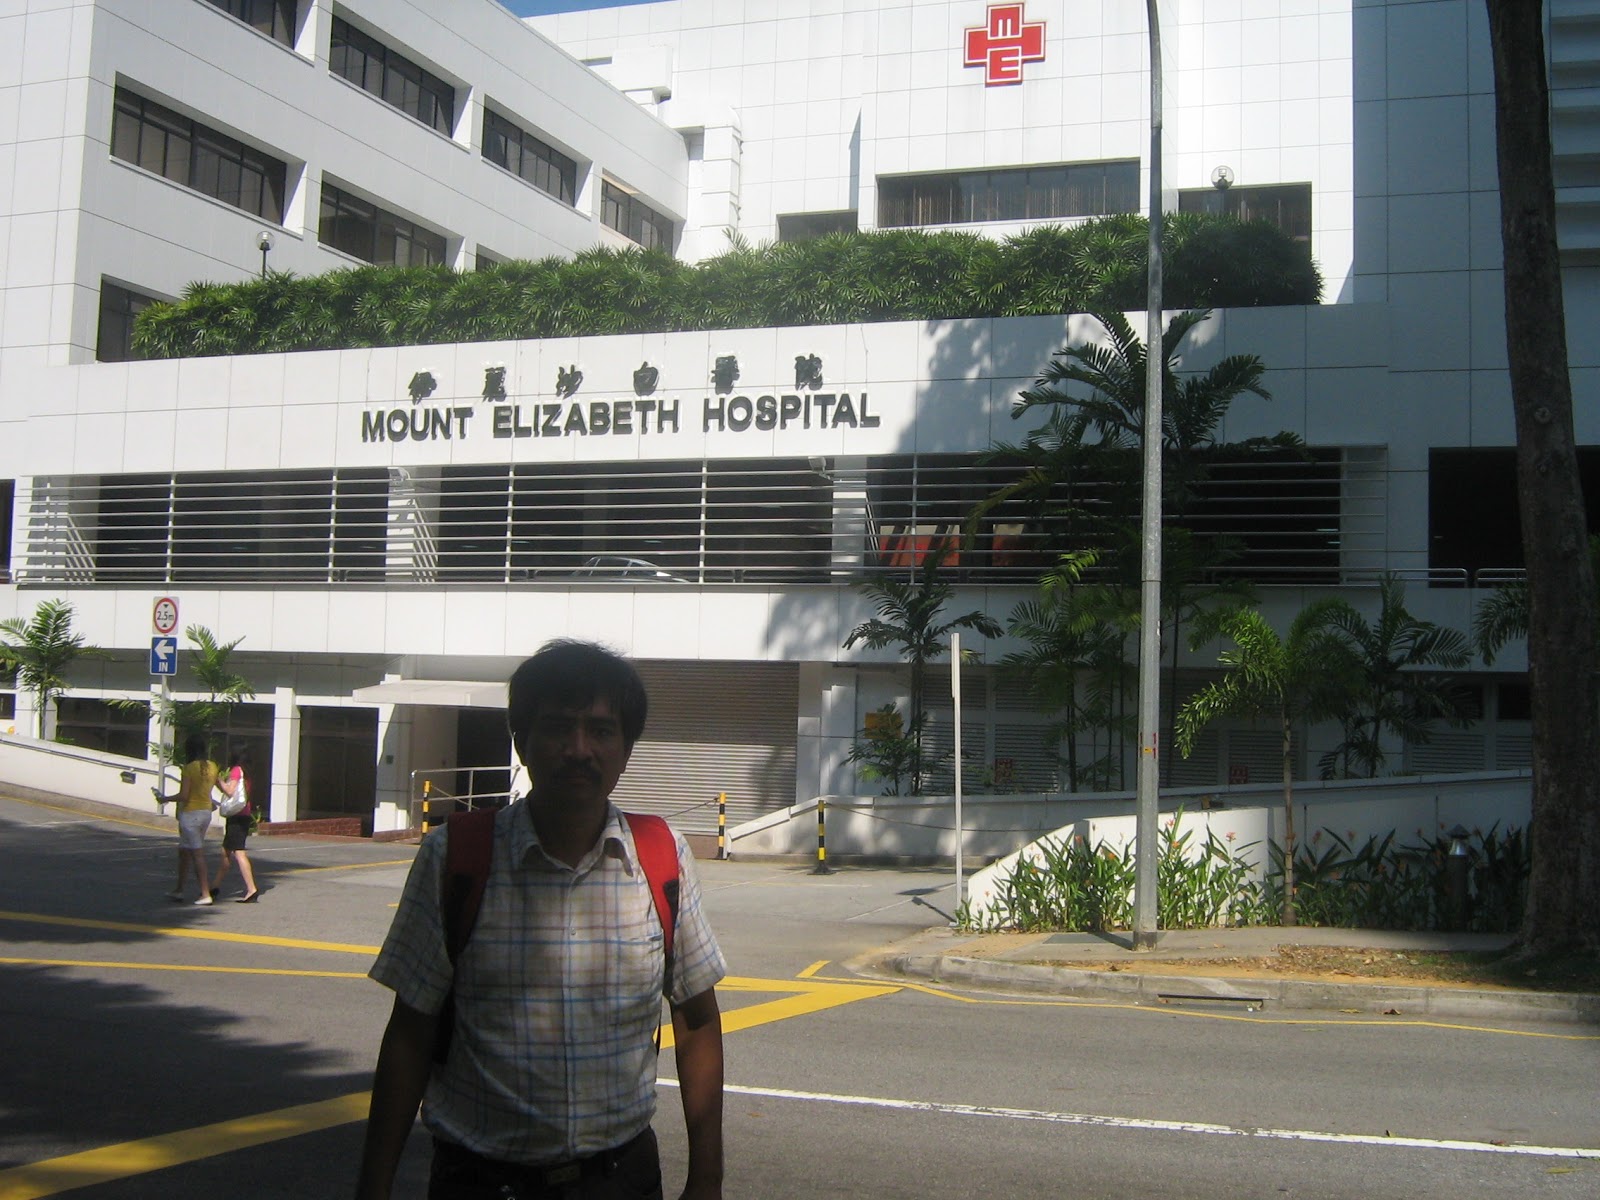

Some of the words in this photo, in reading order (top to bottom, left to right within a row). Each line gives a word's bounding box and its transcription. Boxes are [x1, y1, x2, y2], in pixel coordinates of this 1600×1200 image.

[362, 406, 474, 442] MOUNT
[493, 398, 680, 439] ELIZABETH
[703, 393, 881, 433] HOSPITAL
[156, 611, 175, 621] 2.5m
[158, 661, 169, 673] IN
